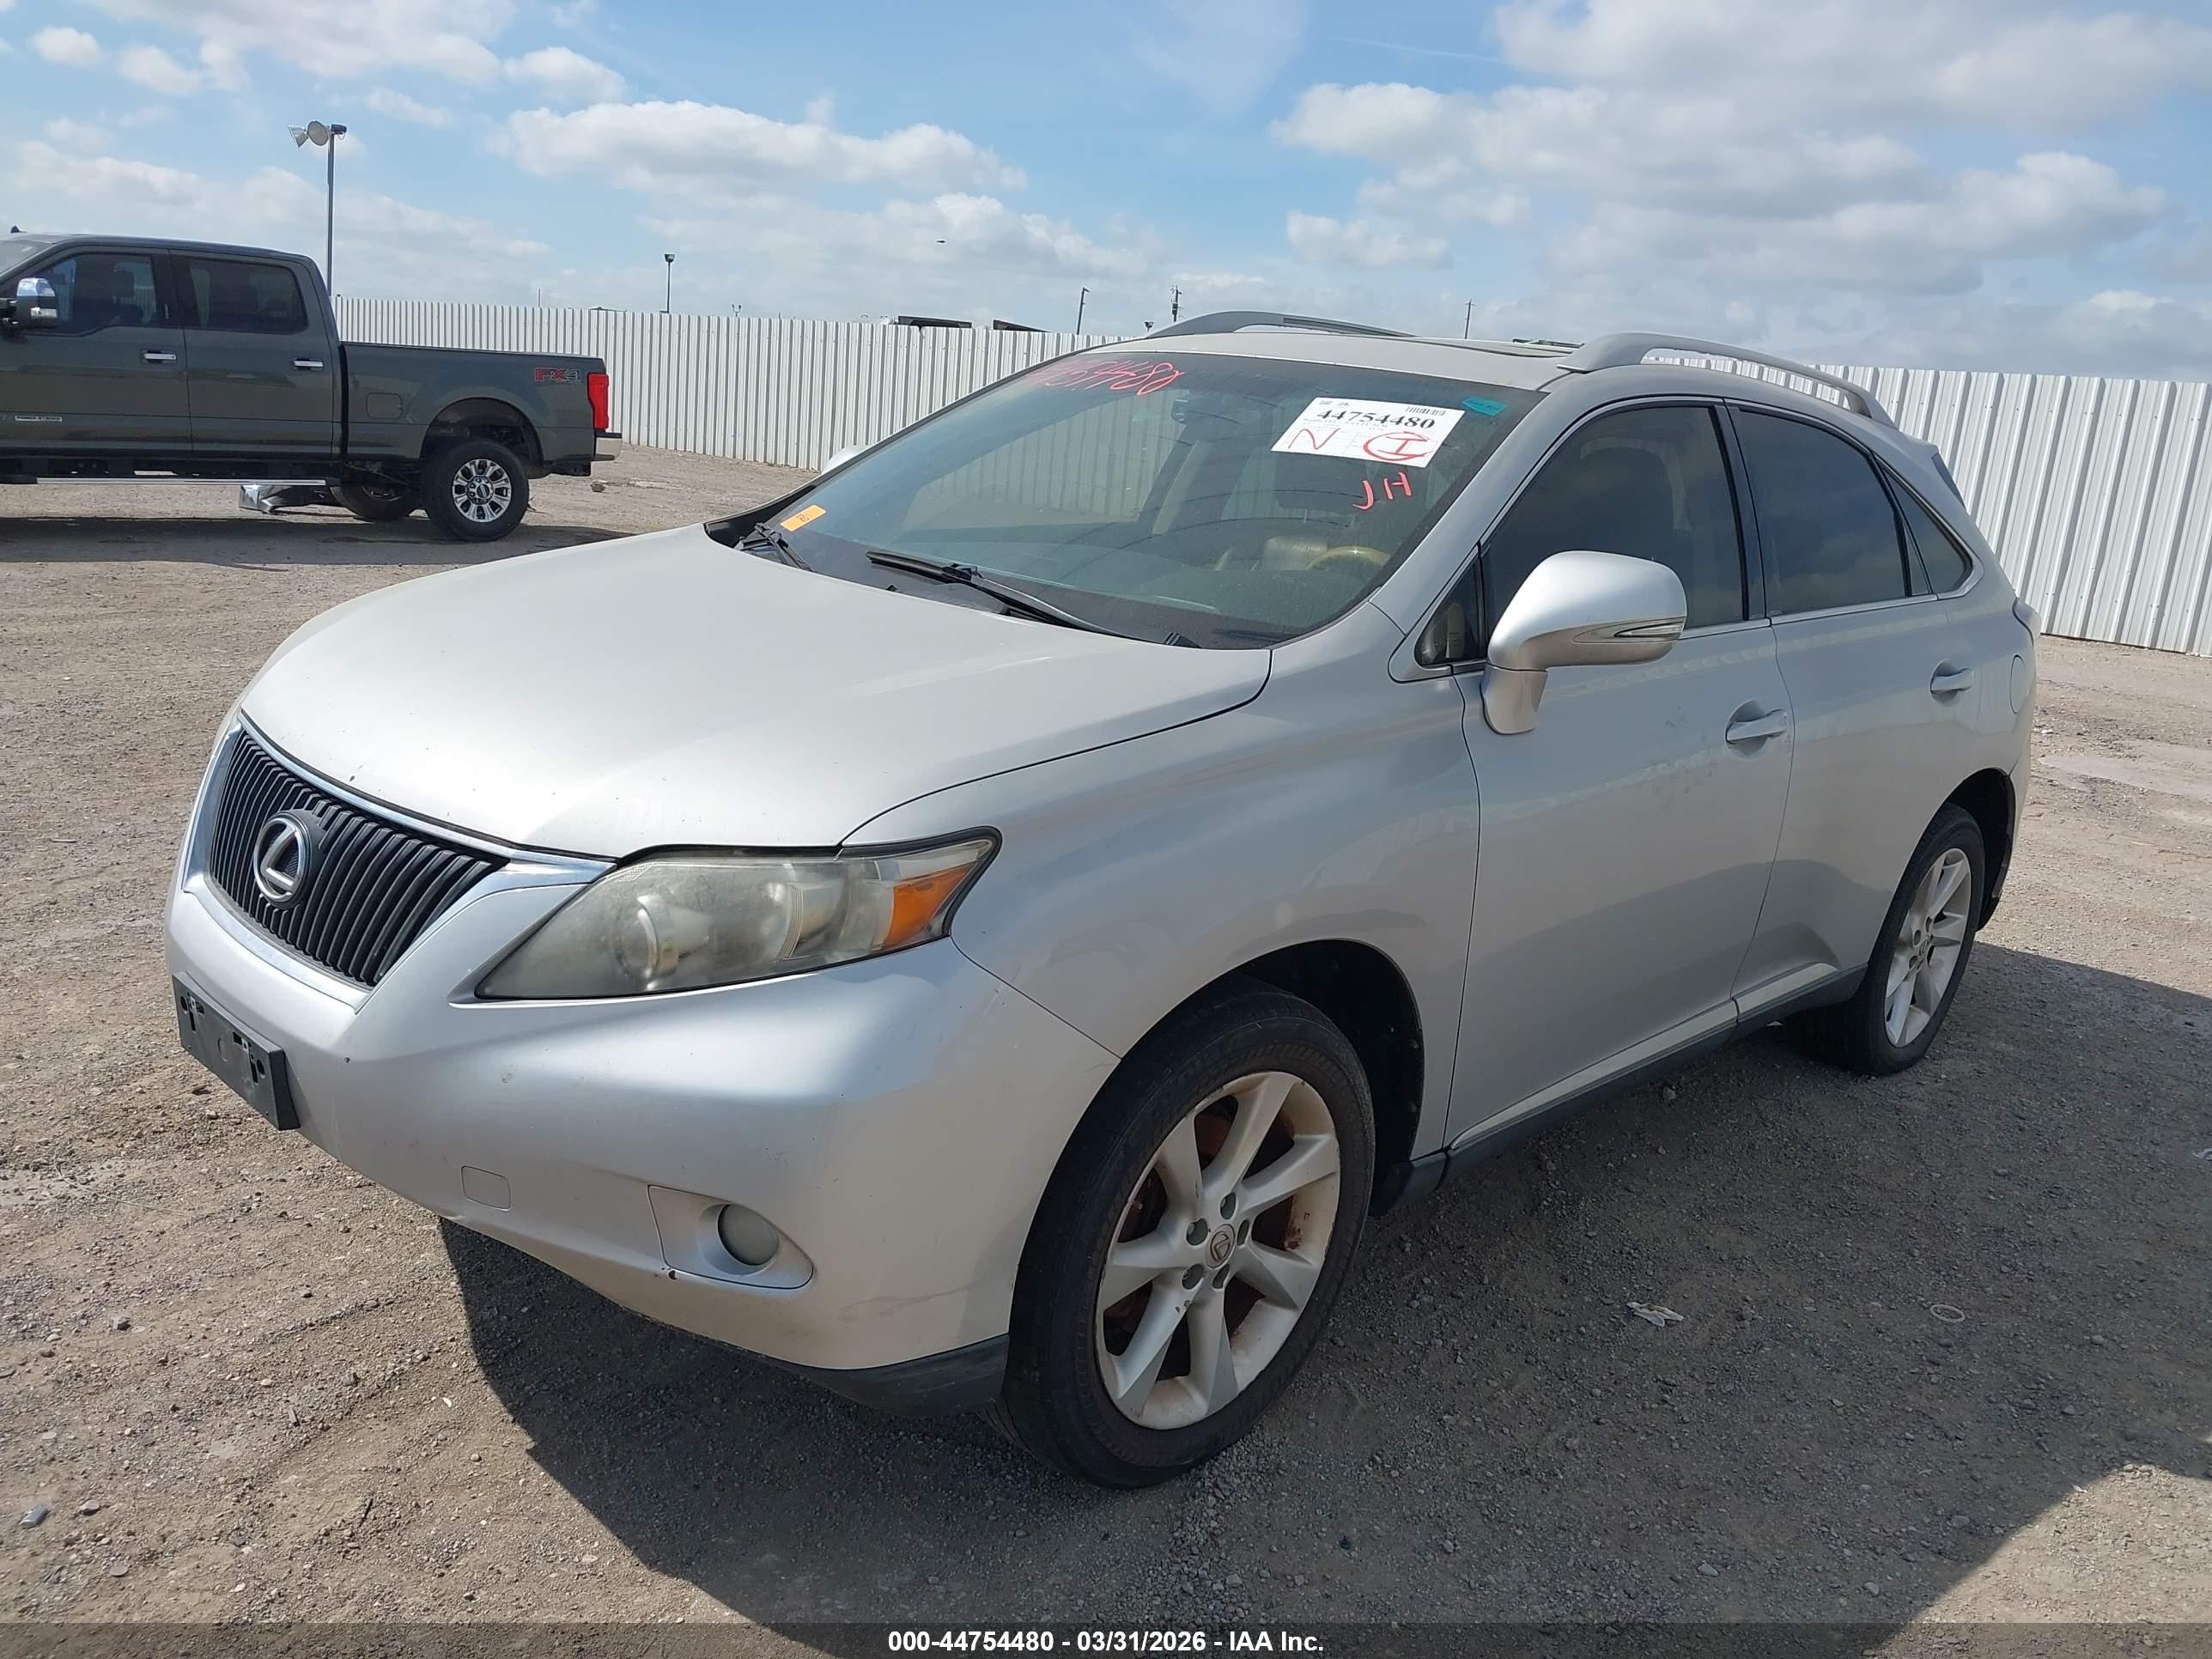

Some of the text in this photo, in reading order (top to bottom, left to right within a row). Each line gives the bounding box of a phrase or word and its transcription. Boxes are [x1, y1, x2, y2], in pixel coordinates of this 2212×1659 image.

[535, 367, 581, 382] FX4
[1316, 410, 1436, 429] 44754480
[1287, 428, 1340, 450] N
